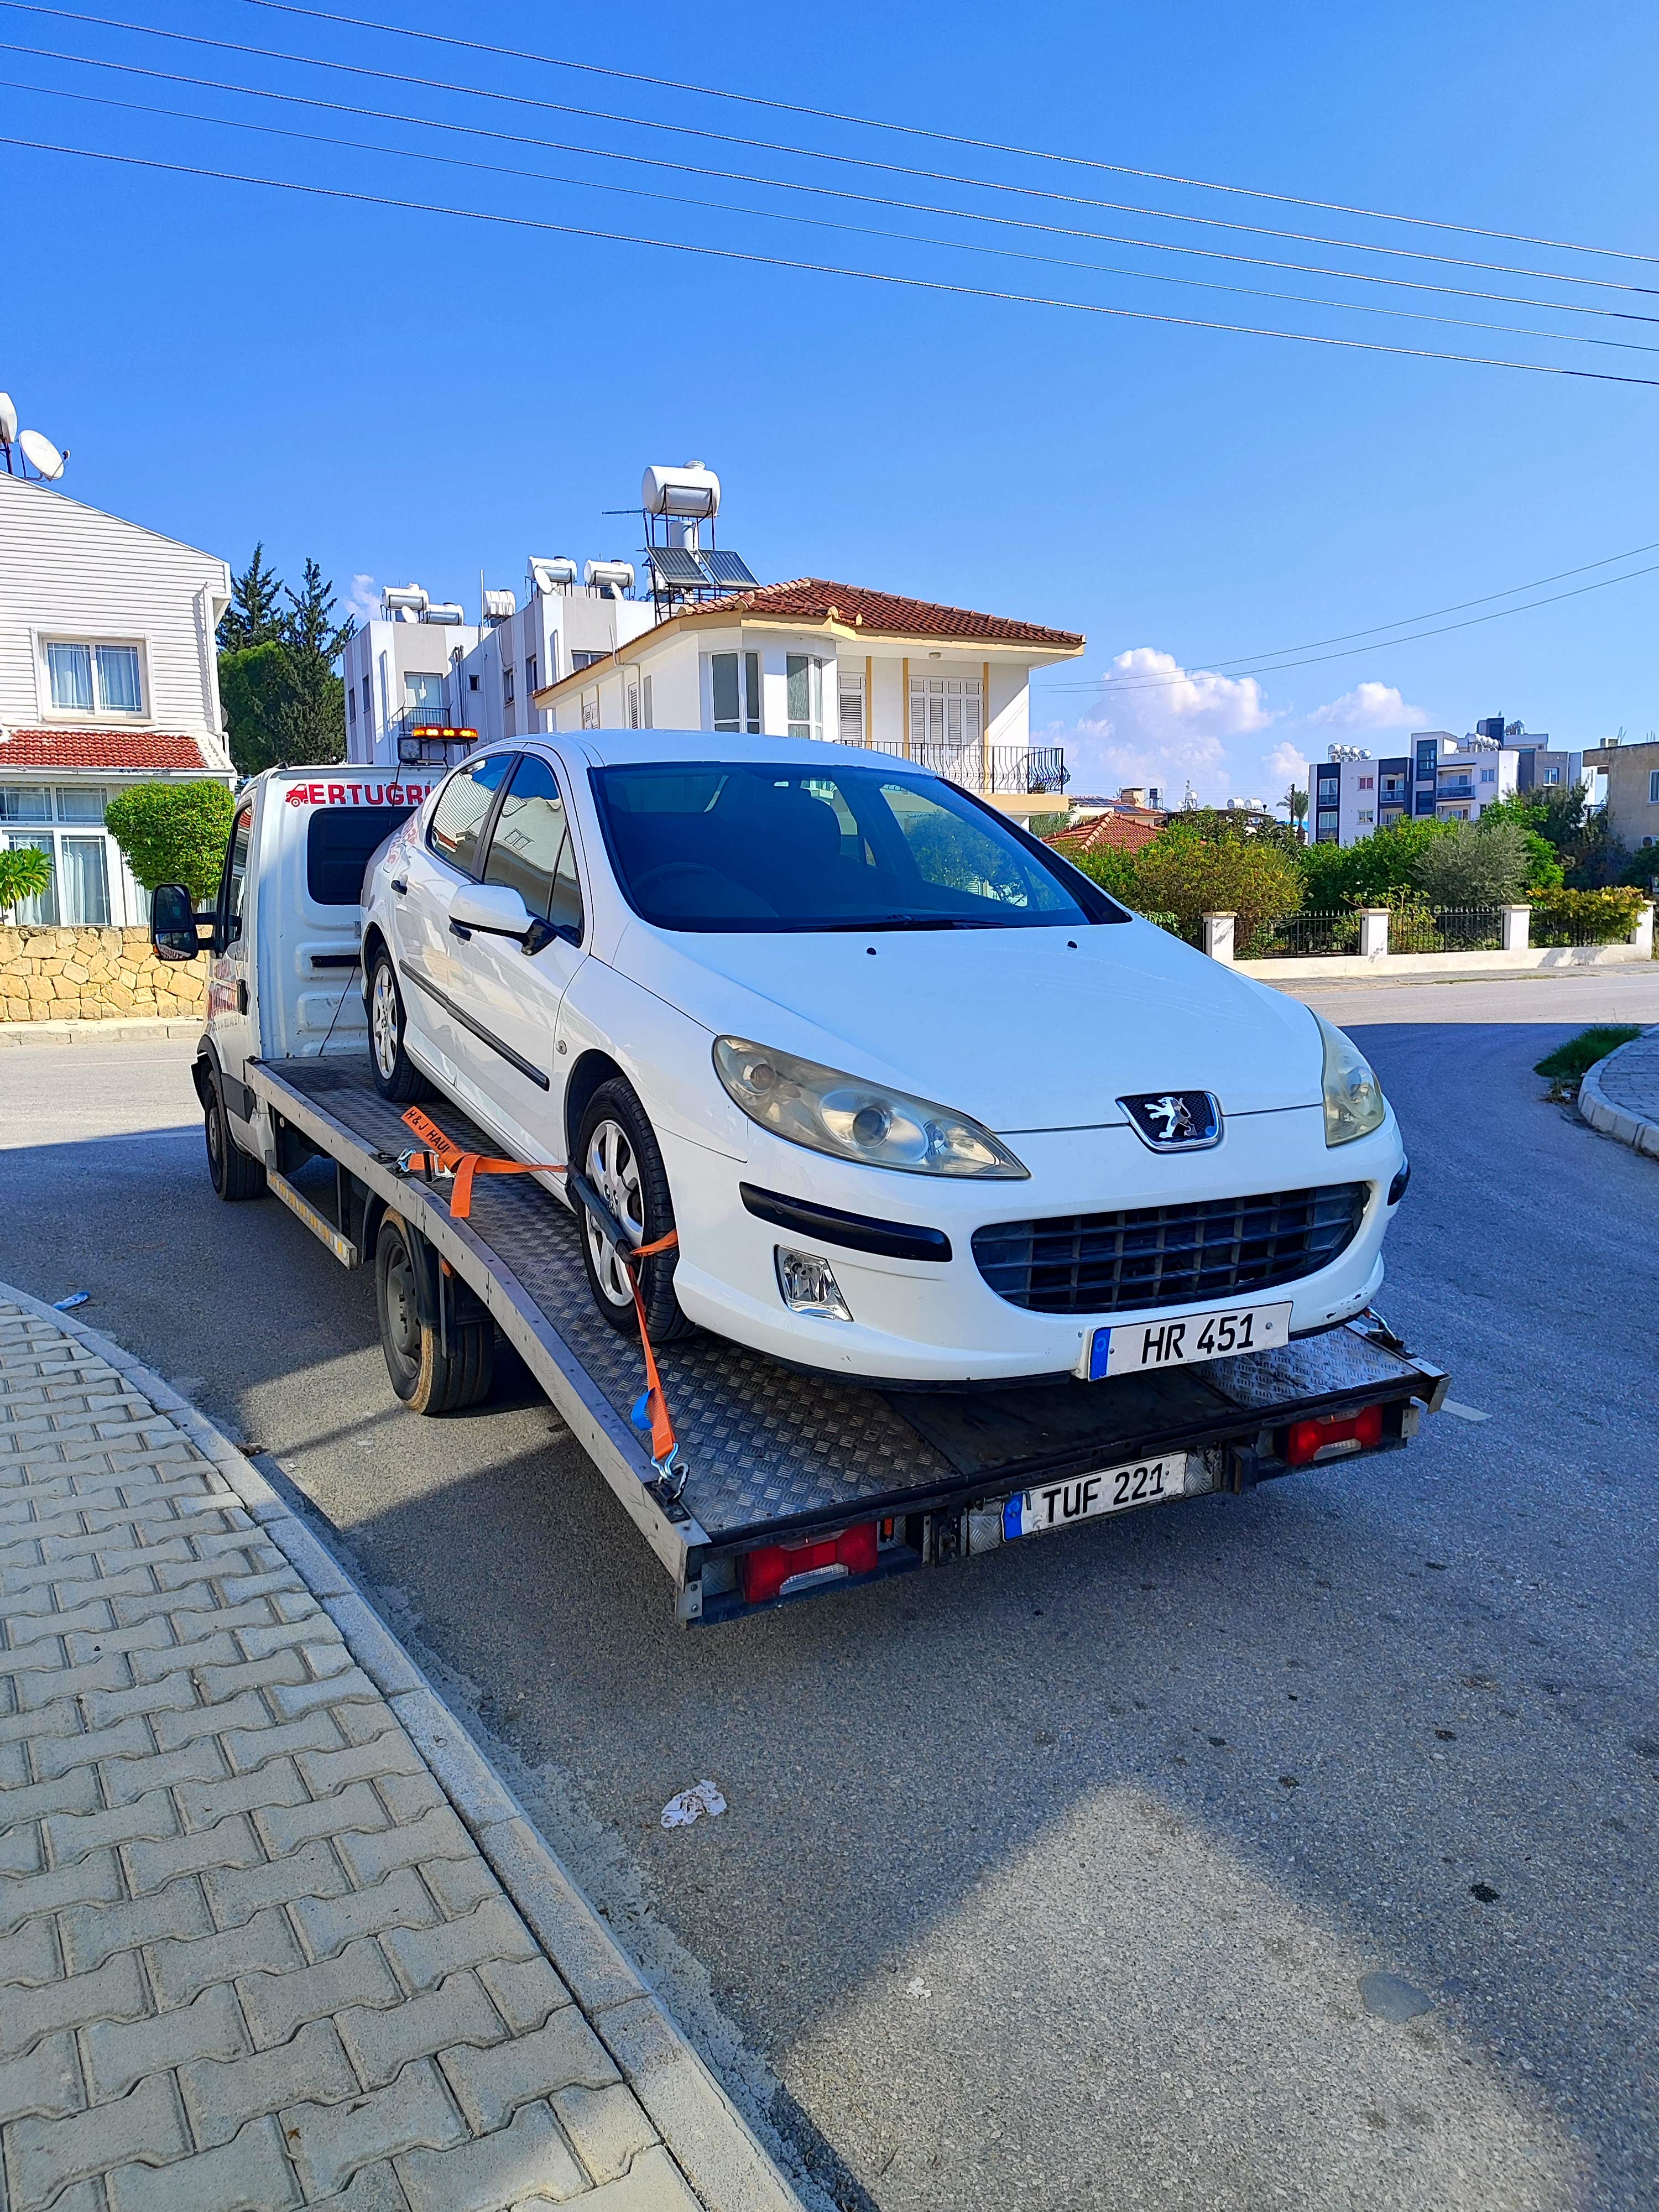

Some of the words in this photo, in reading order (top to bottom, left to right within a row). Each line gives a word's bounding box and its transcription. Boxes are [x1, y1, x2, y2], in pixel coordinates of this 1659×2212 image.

[405, 1109, 417, 1119] H
[412, 1115, 422, 1125] &
[1141, 1323, 1186, 1364] HR
[1197, 1313, 1254, 1354] 451
[1043, 1477, 1102, 1524] TUF
[1113, 1463, 1165, 1505] 221
